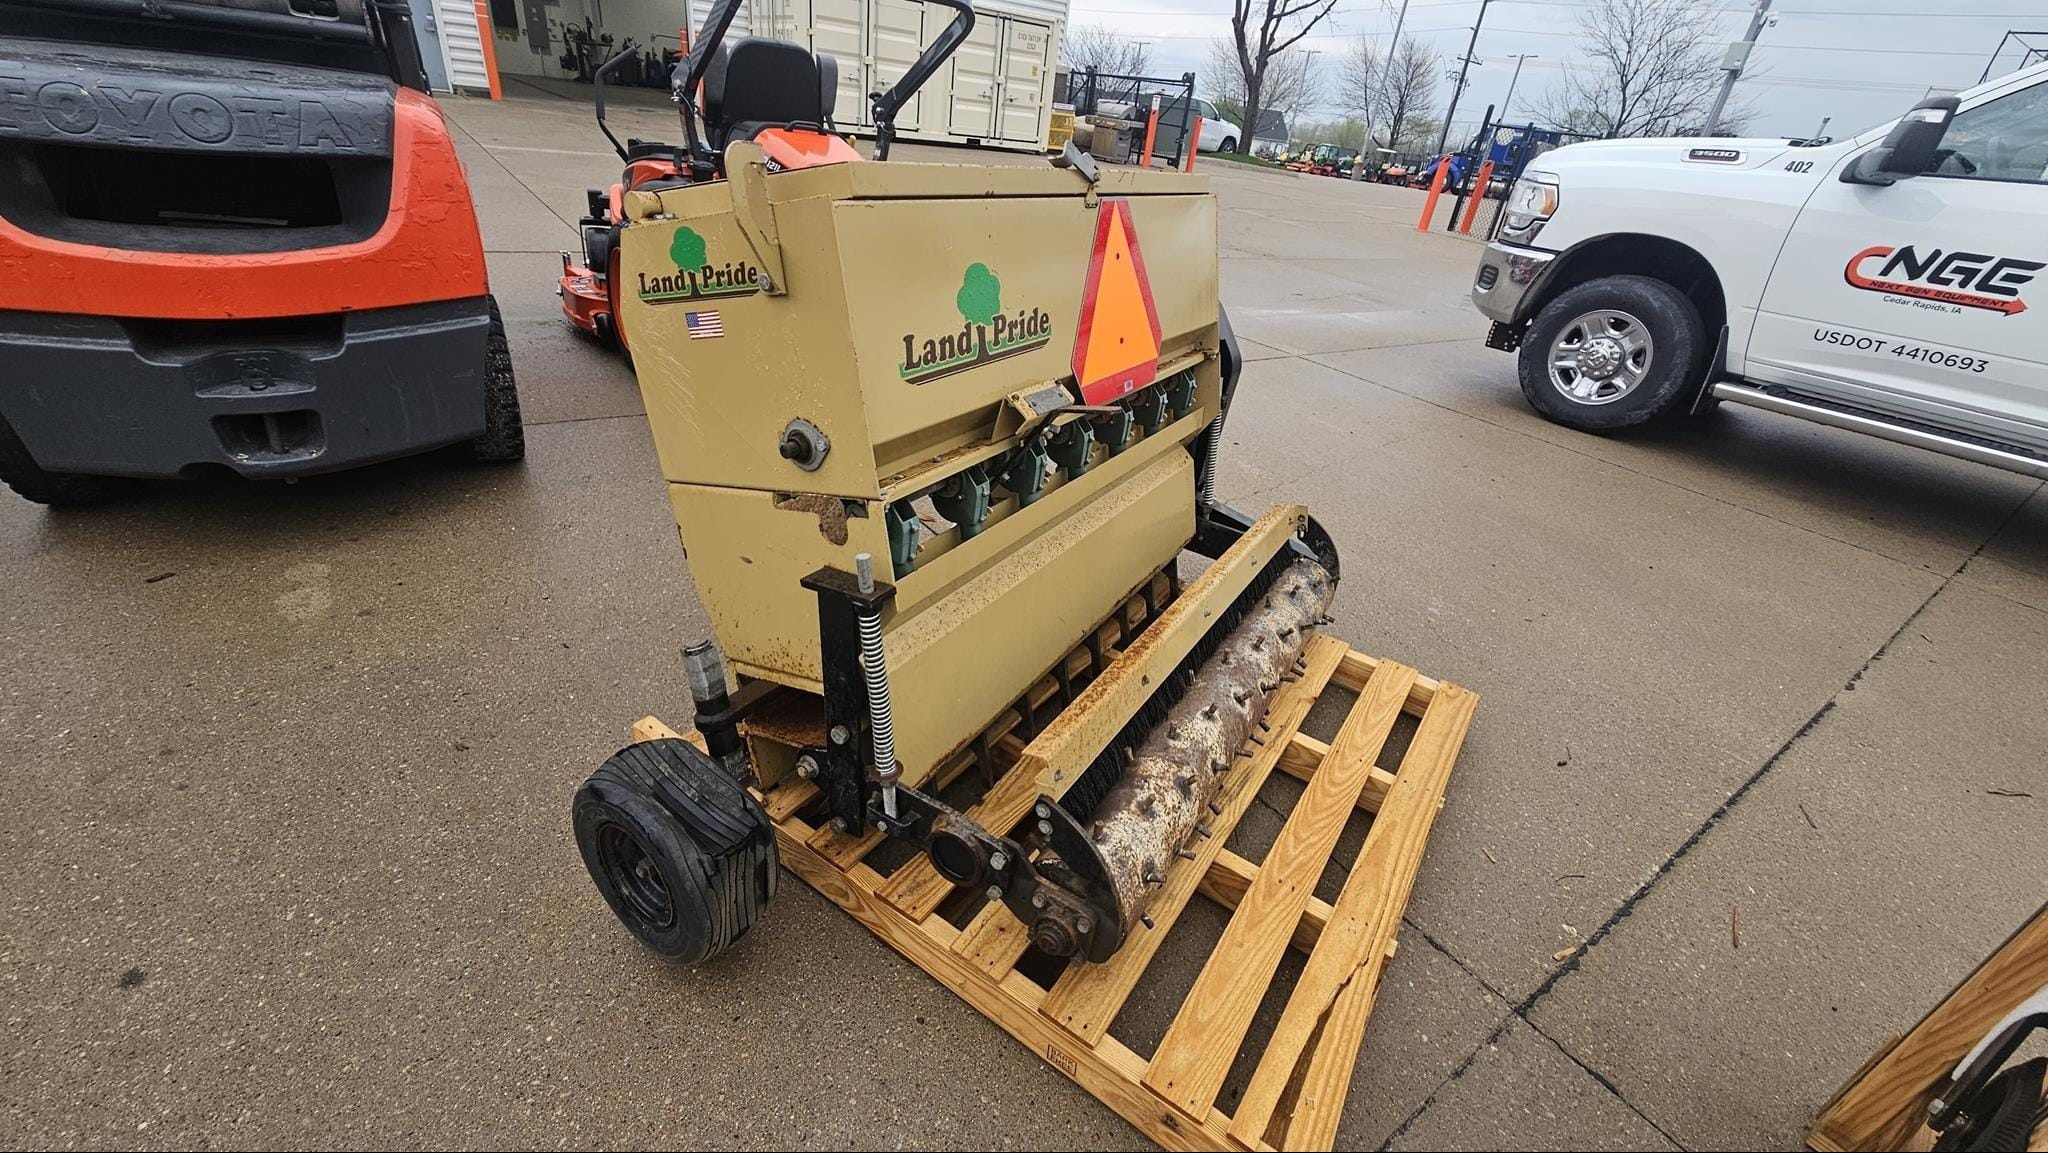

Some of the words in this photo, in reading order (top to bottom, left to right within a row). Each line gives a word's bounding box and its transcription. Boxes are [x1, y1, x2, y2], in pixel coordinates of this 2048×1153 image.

[1784, 161, 1814, 174] 402
[638, 269, 687, 295] Land
[700, 261, 758, 289] Pride
[1870, 281, 1903, 290] NEXT
[1905, 286, 1930, 295] GEN
[1935, 290, 2010, 307] EQUIPMENT
[1883, 295, 1911, 306] Cedar
[1912, 300, 1948, 313] Rapids,
[903, 321, 973, 371] Land
[992, 307, 1050, 347] Pride
[1814, 328, 1887, 353] USDOT
[1891, 345, 1989, 373] 4410693
